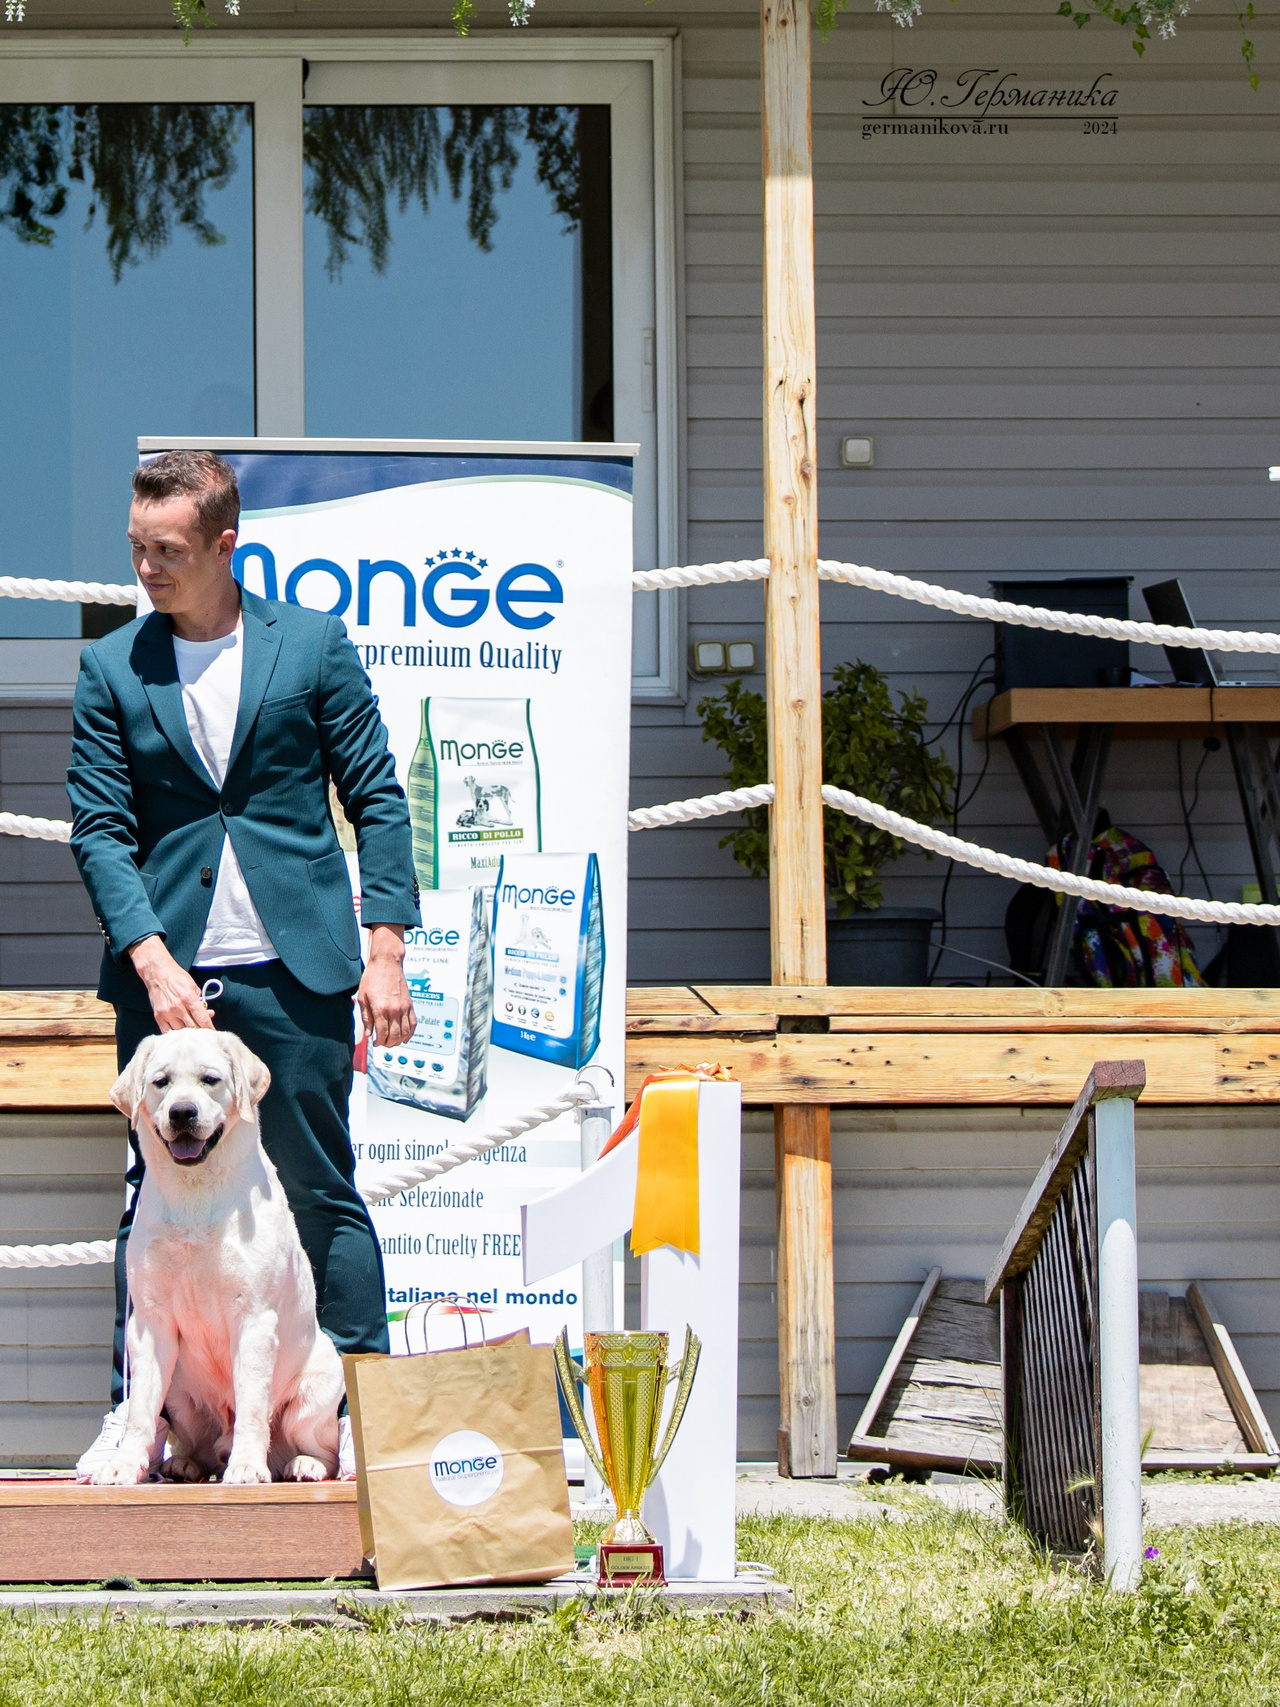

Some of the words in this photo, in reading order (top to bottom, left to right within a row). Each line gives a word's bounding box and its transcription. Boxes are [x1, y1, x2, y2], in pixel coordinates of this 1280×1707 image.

[478, 639, 563, 675] Quality
[452, 832, 479, 841] RICCO
[483, 831, 493, 839] DI
[494, 829, 521, 838] POLLO
[368, 1138, 401, 1164] ogni
[399, 1187, 484, 1209] Selezionate
[380, 1233, 422, 1255] antito
[426, 1233, 478, 1258] Cruelty
[482, 1233, 522, 1256] FREE
[387, 1287, 459, 1303] taliano
[466, 1288, 499, 1304] nel
[506, 1288, 578, 1305] mondo
